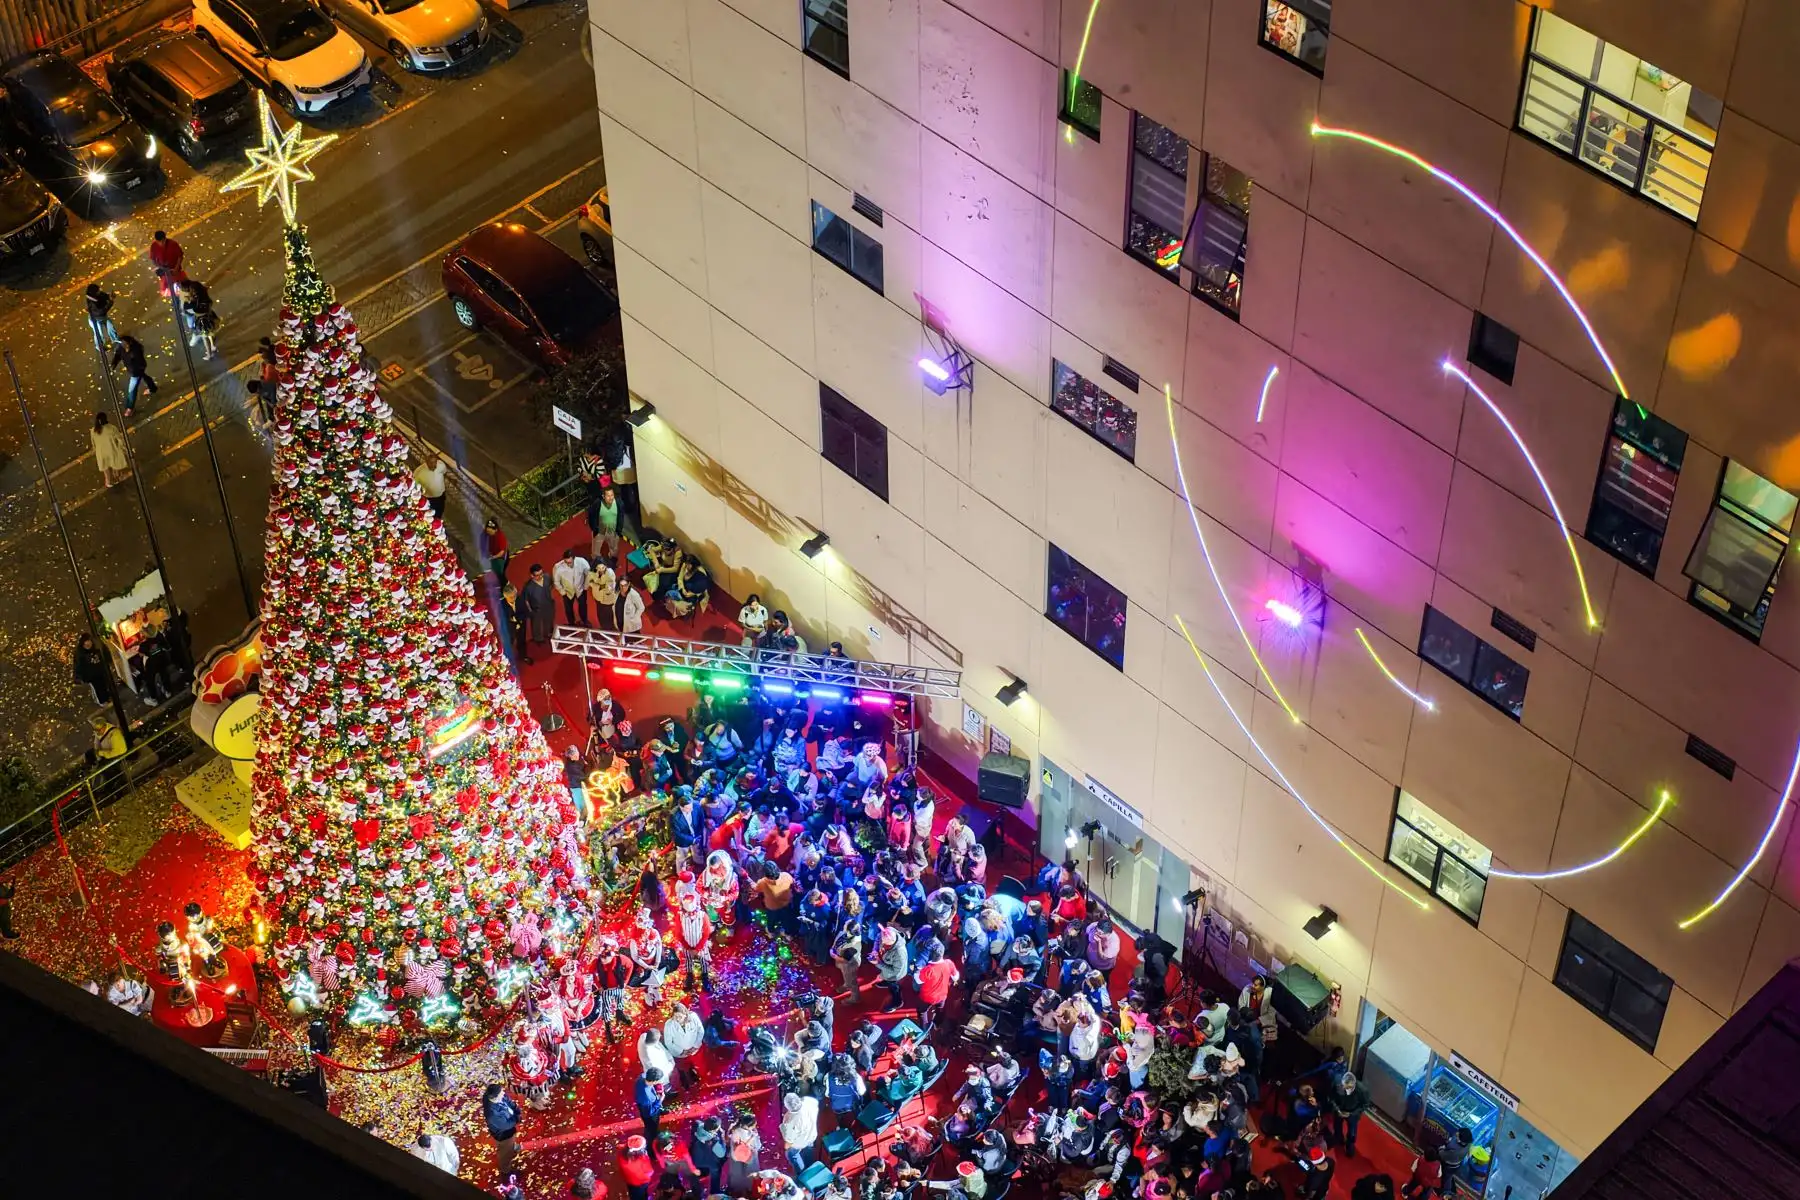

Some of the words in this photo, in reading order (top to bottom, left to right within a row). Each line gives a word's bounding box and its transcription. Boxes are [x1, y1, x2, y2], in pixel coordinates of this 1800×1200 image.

[557, 410, 576, 425] CAJA
[229, 713, 260, 737] Hum
[1103, 794, 1133, 820] CAPILLA
[1467, 1070, 1514, 1108] CAFETERIA
